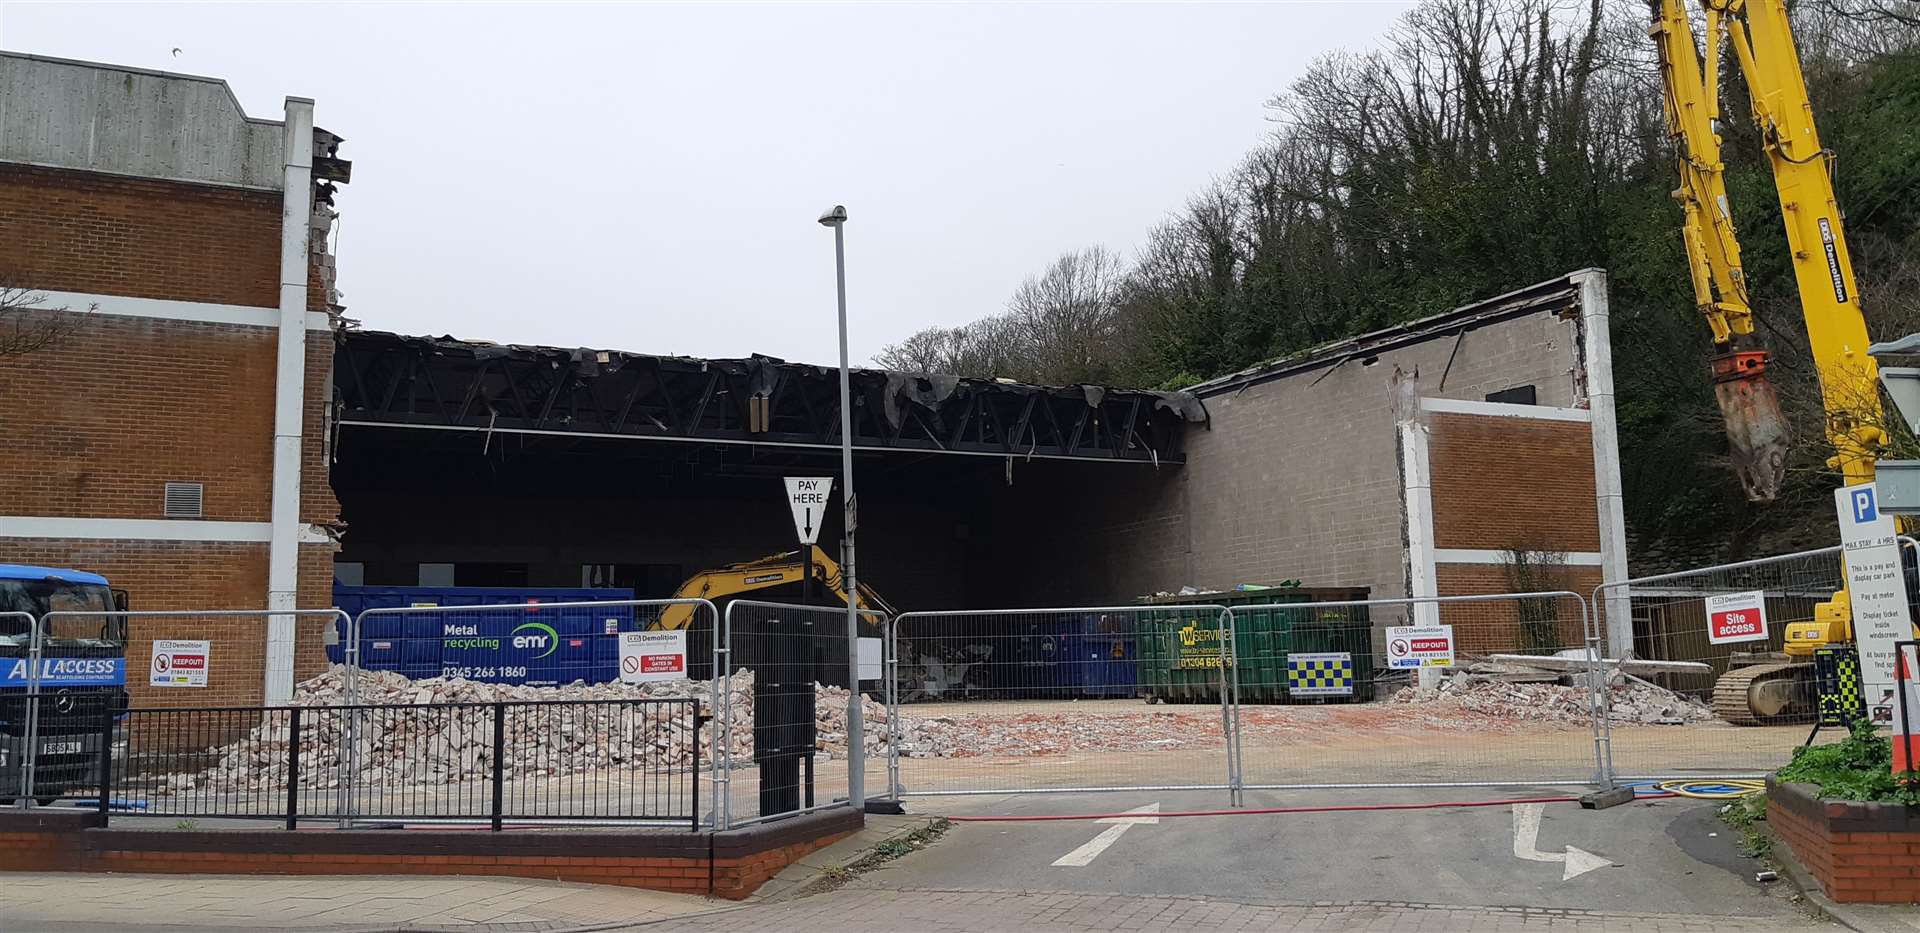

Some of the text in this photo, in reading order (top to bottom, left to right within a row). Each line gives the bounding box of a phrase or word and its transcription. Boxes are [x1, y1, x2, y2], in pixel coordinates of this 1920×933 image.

[1826, 244, 1844, 302] Demolition
[798, 481, 818, 490] PAY
[793, 494, 823, 503] HERE
[1856, 492, 1869, 519] P
[1845, 541, 1857, 549] MAX
[1859, 539, 1871, 548] STAY
[1883, 536, 1895, 544] HRS
[1852, 564, 1862, 572] This
[1886, 561, 1895, 569] and
[1855, 574, 1871, 582] display
[1883, 572, 1895, 580] park
[1726, 613, 1745, 624] Site
[445, 625, 477, 635] Metal
[1720, 623, 1755, 635] access
[444, 638, 499, 649] recycling
[513, 635, 548, 648] emr
[1874, 651, 1886, 659] busy
[53, 660, 114, 673] ACCESS
[443, 667, 526, 677] 0345 266 1860
